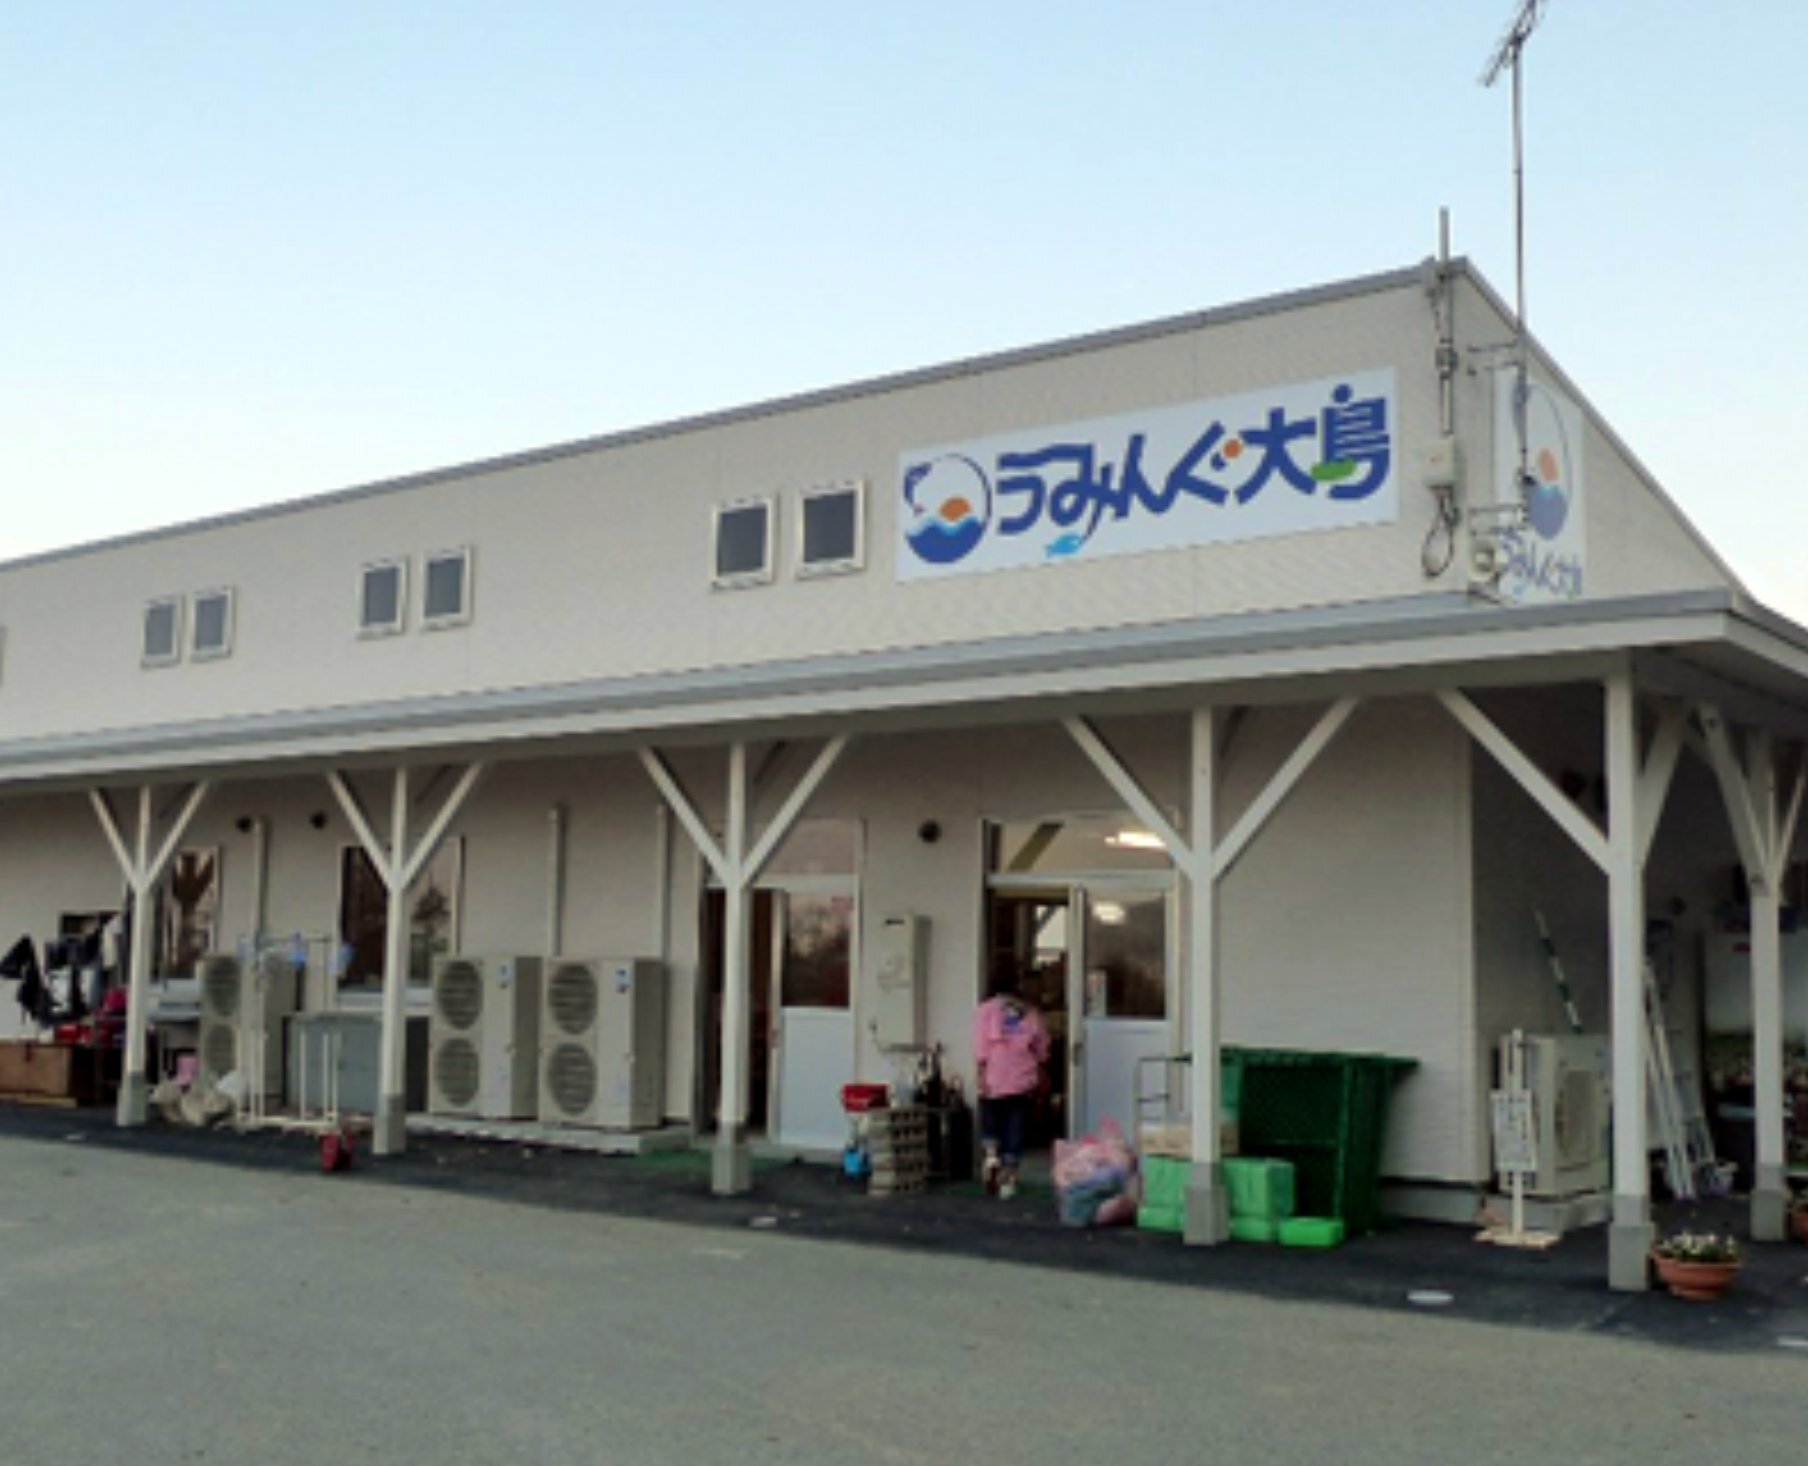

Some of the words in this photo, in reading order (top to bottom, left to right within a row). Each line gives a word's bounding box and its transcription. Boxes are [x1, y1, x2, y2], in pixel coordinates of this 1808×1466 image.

[997, 384, 1391, 538] うみんぐ大島
